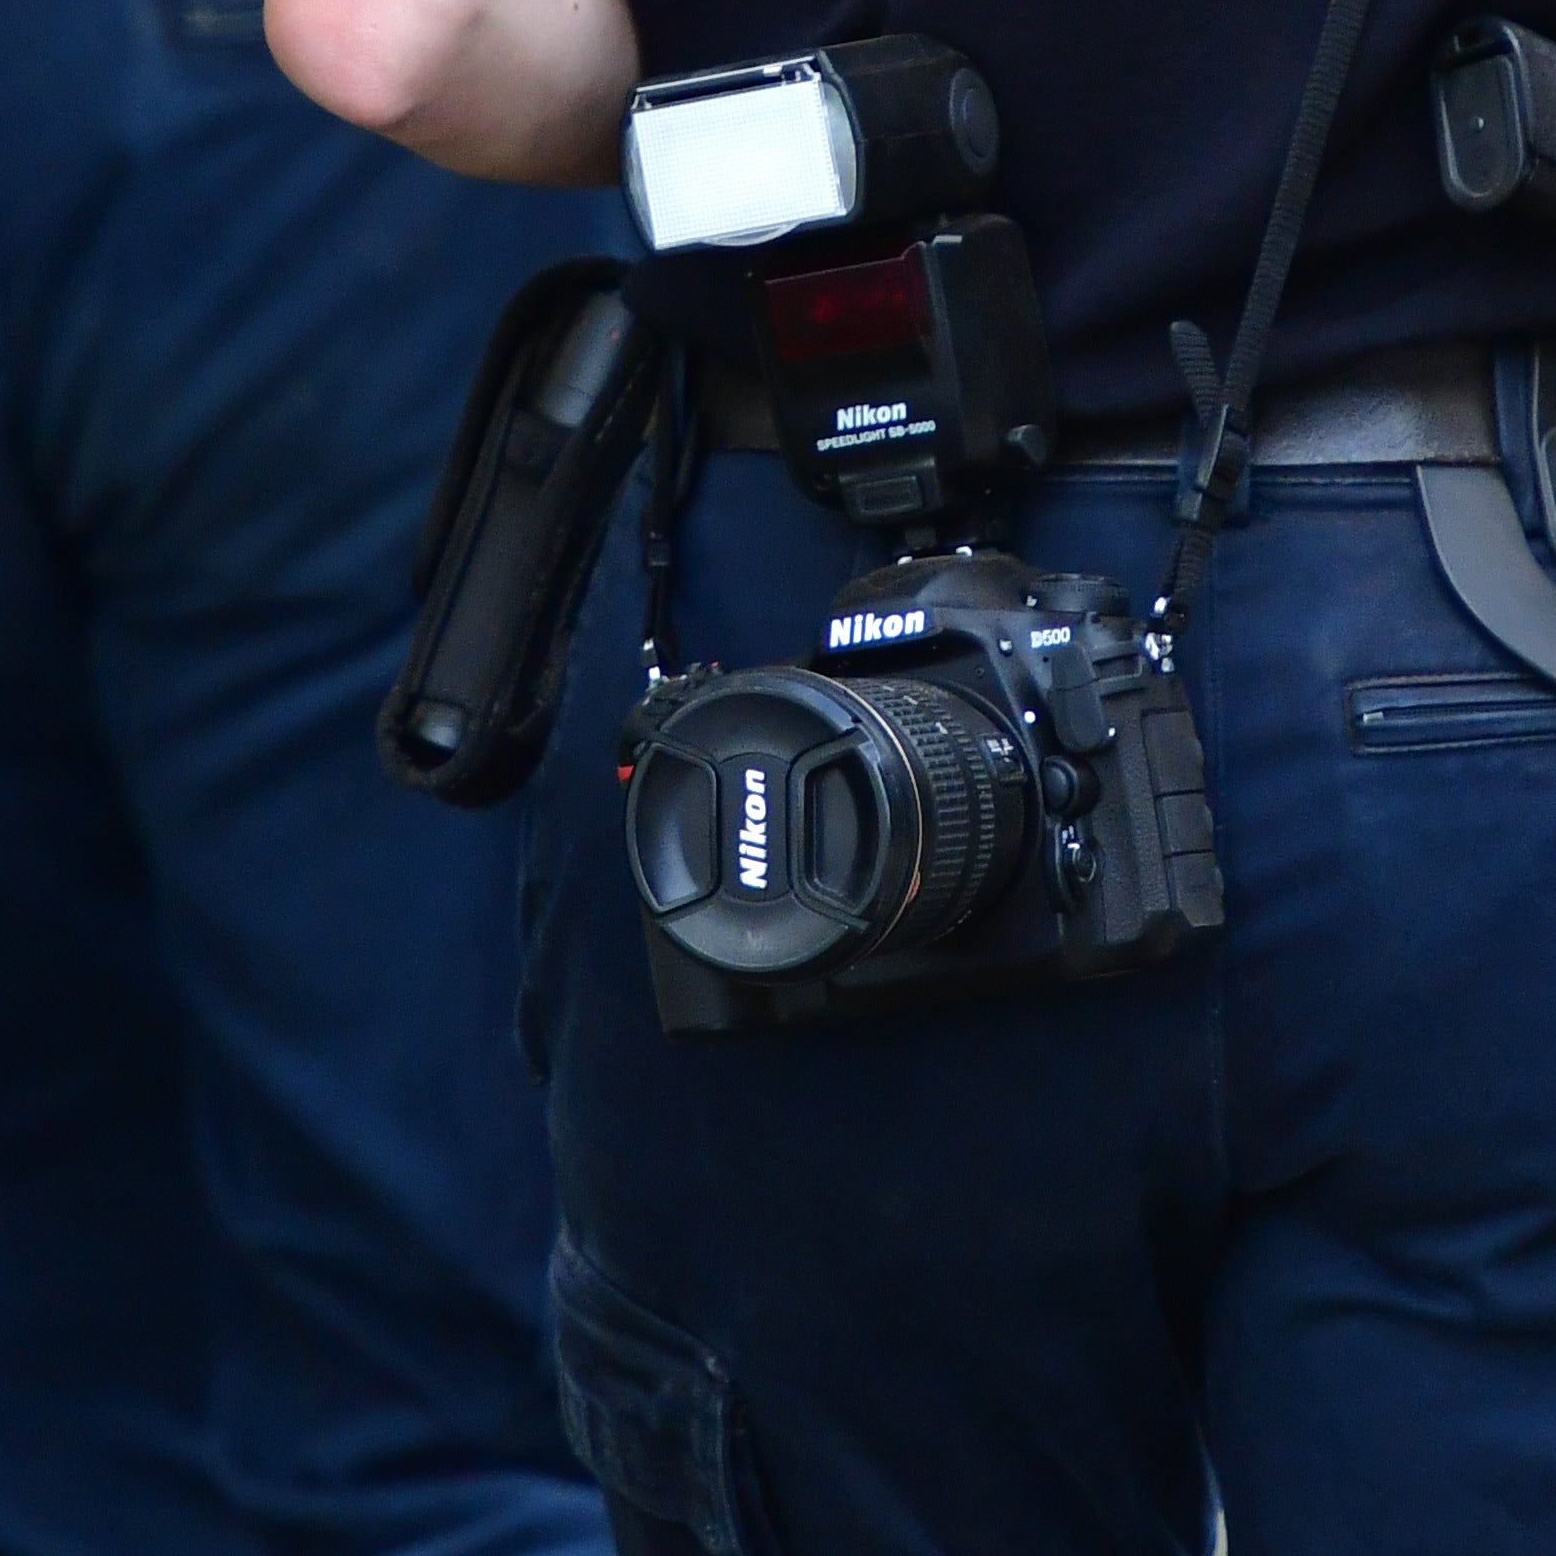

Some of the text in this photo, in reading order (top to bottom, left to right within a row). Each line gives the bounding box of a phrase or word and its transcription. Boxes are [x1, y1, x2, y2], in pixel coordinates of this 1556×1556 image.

[837, 402, 907, 431] Nikon
[816, 428, 886, 452] SPEEDLIGHT
[829, 610, 925, 648] Nikon
[1030, 627, 1071, 649] D500
[739, 768, 768, 890] Nikon
